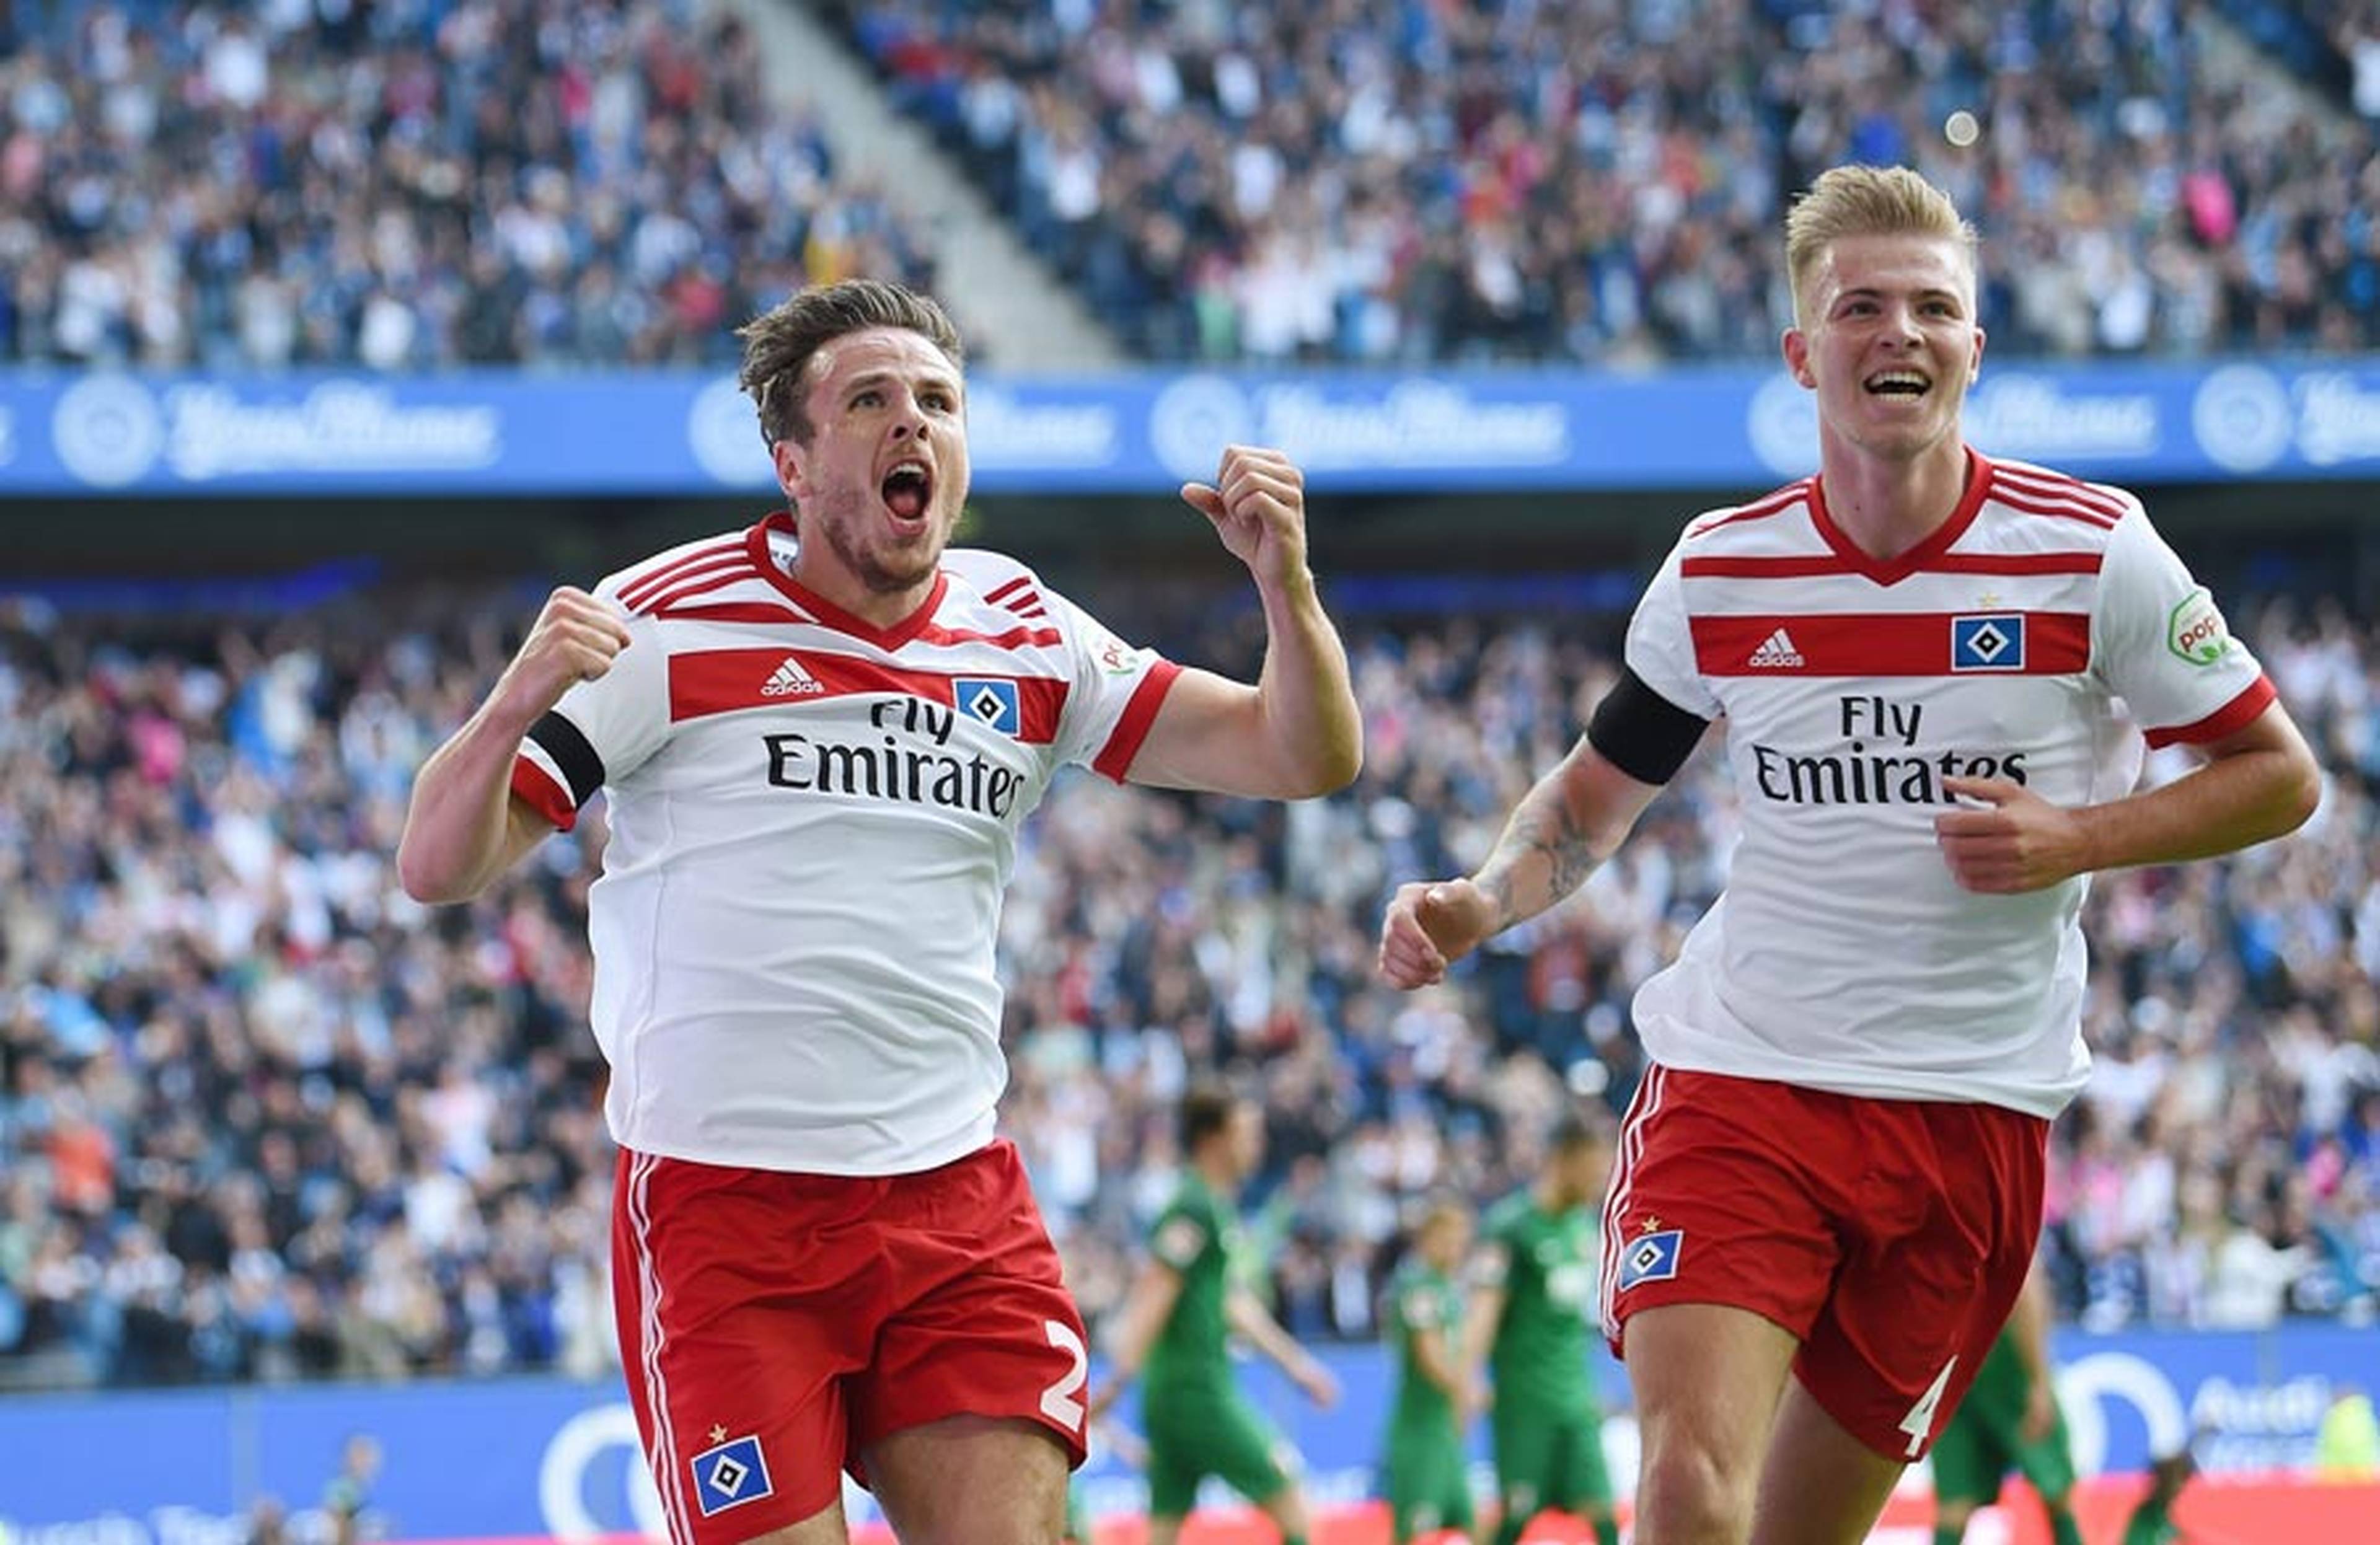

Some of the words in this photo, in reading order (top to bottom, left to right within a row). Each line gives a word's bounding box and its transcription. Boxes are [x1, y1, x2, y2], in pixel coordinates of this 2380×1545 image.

[1748, 654, 1805, 667] adidas
[760, 680, 826, 697] adidas
[1840, 696, 1921, 746] Fly
[1039, 1319, 1088, 1433] 2
[1898, 1354, 1960, 1458] 4
